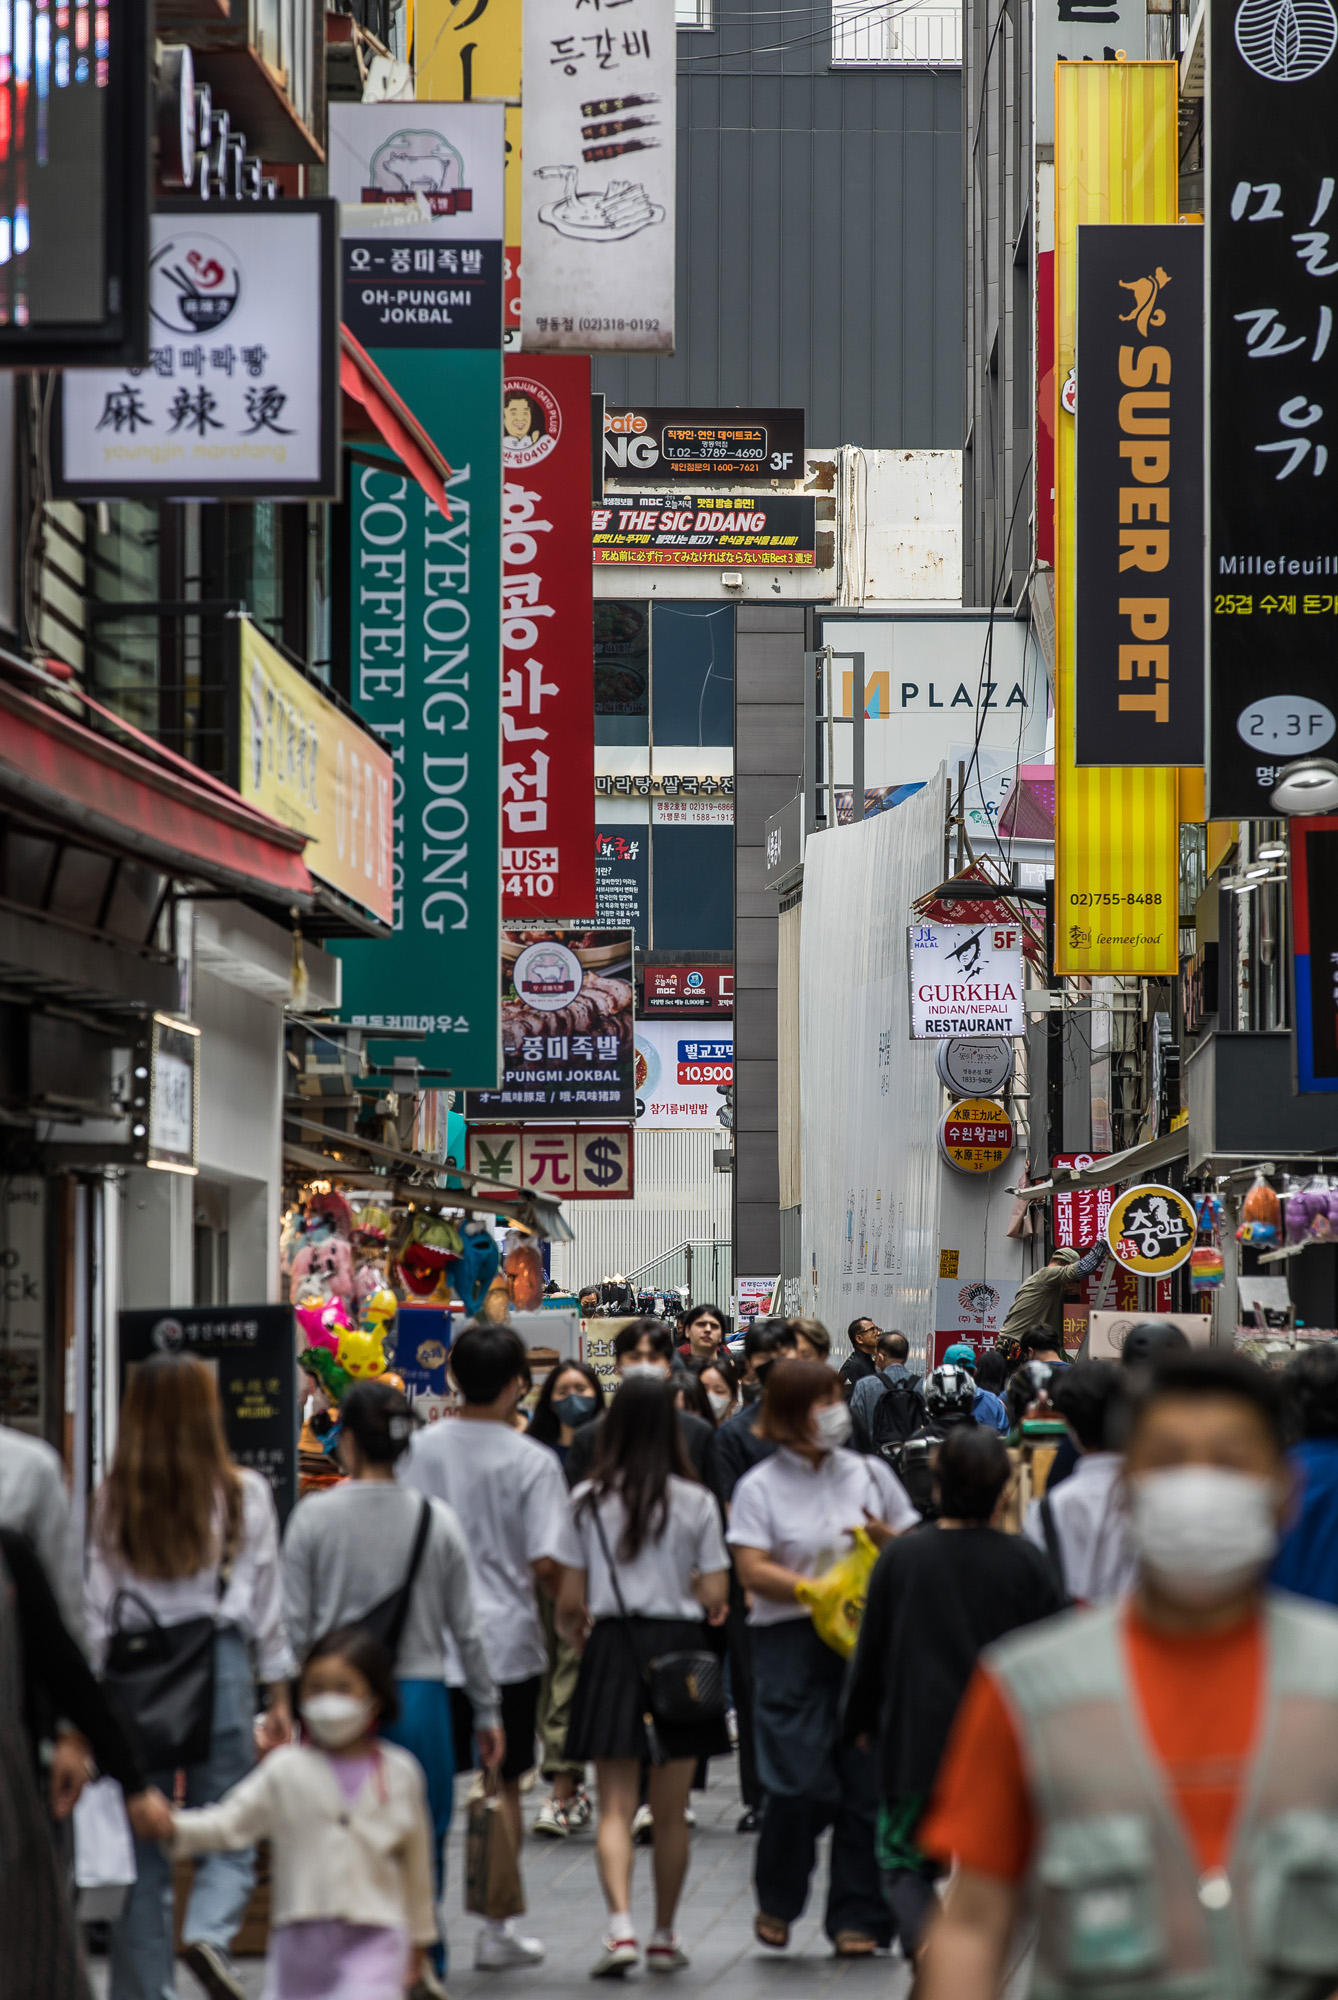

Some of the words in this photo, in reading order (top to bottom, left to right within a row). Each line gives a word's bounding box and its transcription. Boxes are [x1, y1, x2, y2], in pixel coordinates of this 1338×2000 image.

[550, 27, 650, 75] 등갈비
[349, 248, 483, 273] 오-풍미족발
[361, 289, 471, 306] OH-PUNGMI
[380, 308, 452, 324] JOKBAL
[536, 317, 574, 332] 명동점
[579, 317, 660, 332] (02)318-0192
[128, 345, 267, 377] 진마라탕
[95, 384, 297, 436] 麻辣烫
[717, 431, 762, 440] 데이트코스
[670, 463, 711, 472] 체인점문의
[713, 464, 759, 472] 1600-7621
[770, 452, 793, 470] 3F
[1117, 345, 1172, 573] SUPER
[639, 498, 663, 506] MBC
[664, 500, 692, 509] 오늘저녁
[697, 498, 714, 508] 맛집
[715, 499, 733, 508] 방송
[618, 510, 660, 531] THE
[658, 510, 694, 531] SIC
[694, 511, 766, 532] DDANG
[360, 466, 408, 701] COFFEE
[423, 463, 471, 736] MYEONG
[1214, 594, 1253, 615] 25겹
[1259, 594, 1297, 615] 수제
[503, 482, 560, 834] 홍콩반점
[1117, 597, 1171, 723] PET
[901, 682, 1029, 708] PLAZA
[657, 802, 687, 811] 명동2호점
[659, 813, 687, 821] 가맹문의
[421, 752, 469, 934] DONG
[502, 849, 557, 871] LUS+
[1070, 893, 1162, 907] 02)755-8488
[993, 931, 1017, 949] 5F
[1096, 933, 1164, 947] leemeefood
[918, 983, 1018, 1002] GURKHA
[928, 1004, 1008, 1015] INDIAN/NEPALI
[925, 1019, 1013, 1032] RESTAURANT
[565, 1071, 621, 1082] JOKBAL
[962, 1076, 993, 1084] 1833-9406
[650, 1103, 709, 1115] 참기름비빔밥
[954, 1109, 1002, 1121] 水原王カルビ
[949, 1127, 1008, 1142] 수원왕갈비
[528, 1140, 571, 1185] 元
[954, 1150, 1003, 1162] 水原王牛排
[1116, 1240, 1140, 1259] 명동
